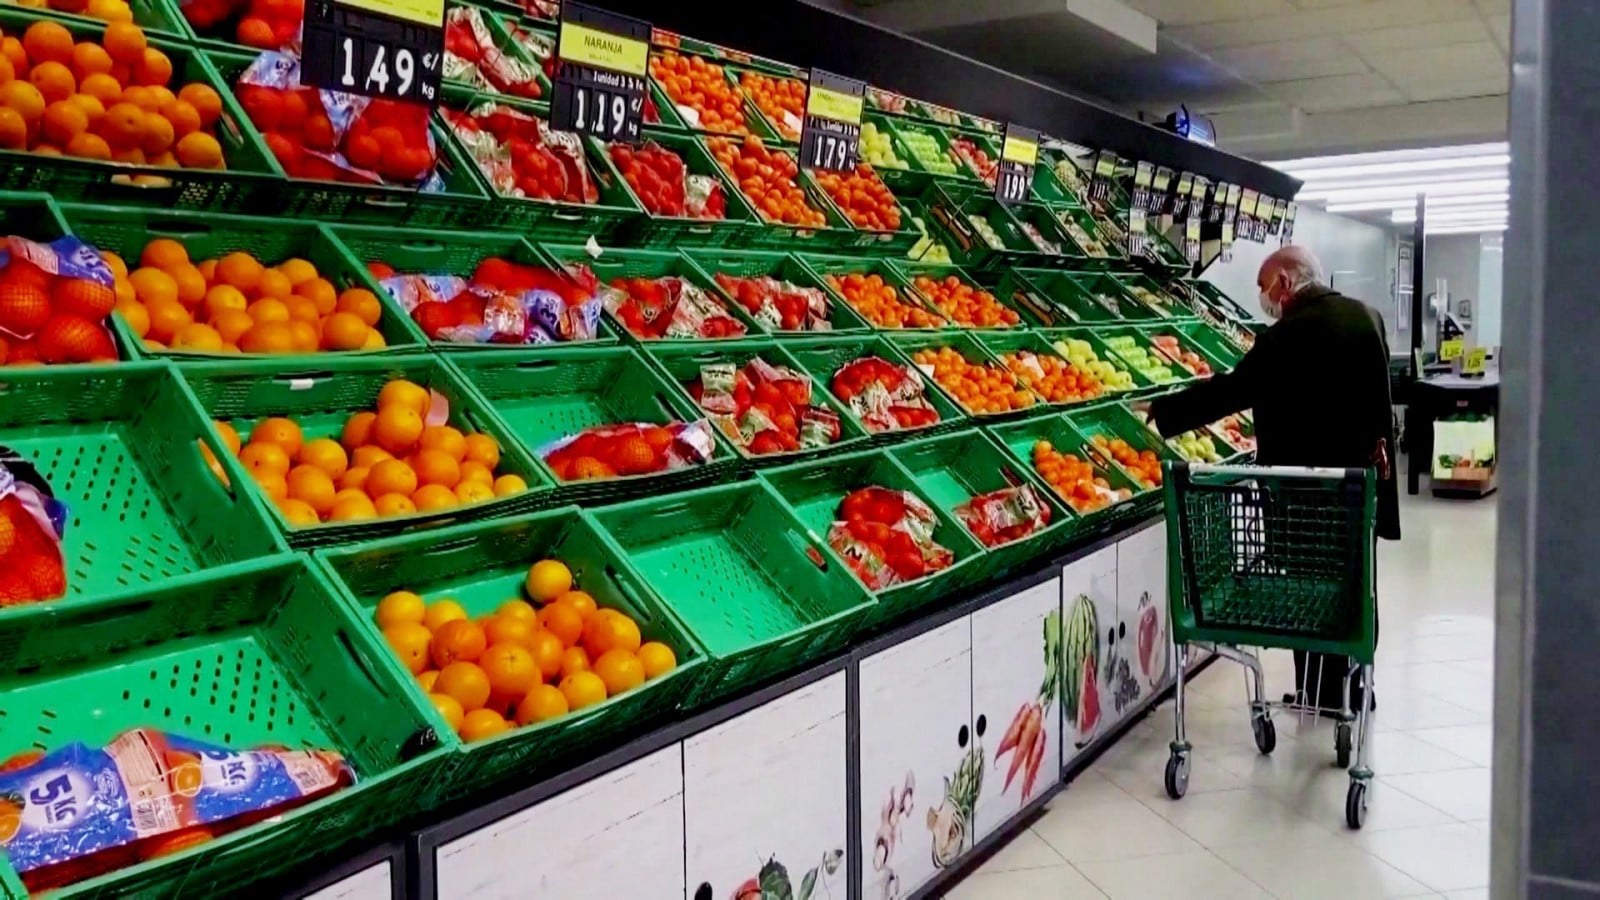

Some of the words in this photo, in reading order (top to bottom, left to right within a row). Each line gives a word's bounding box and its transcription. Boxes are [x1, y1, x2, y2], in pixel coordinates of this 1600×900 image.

[584, 35, 622, 54] NARANJA
[422, 82, 435, 100] kg
[30, 774, 72, 805] 5
[54, 796, 76, 821] KG
